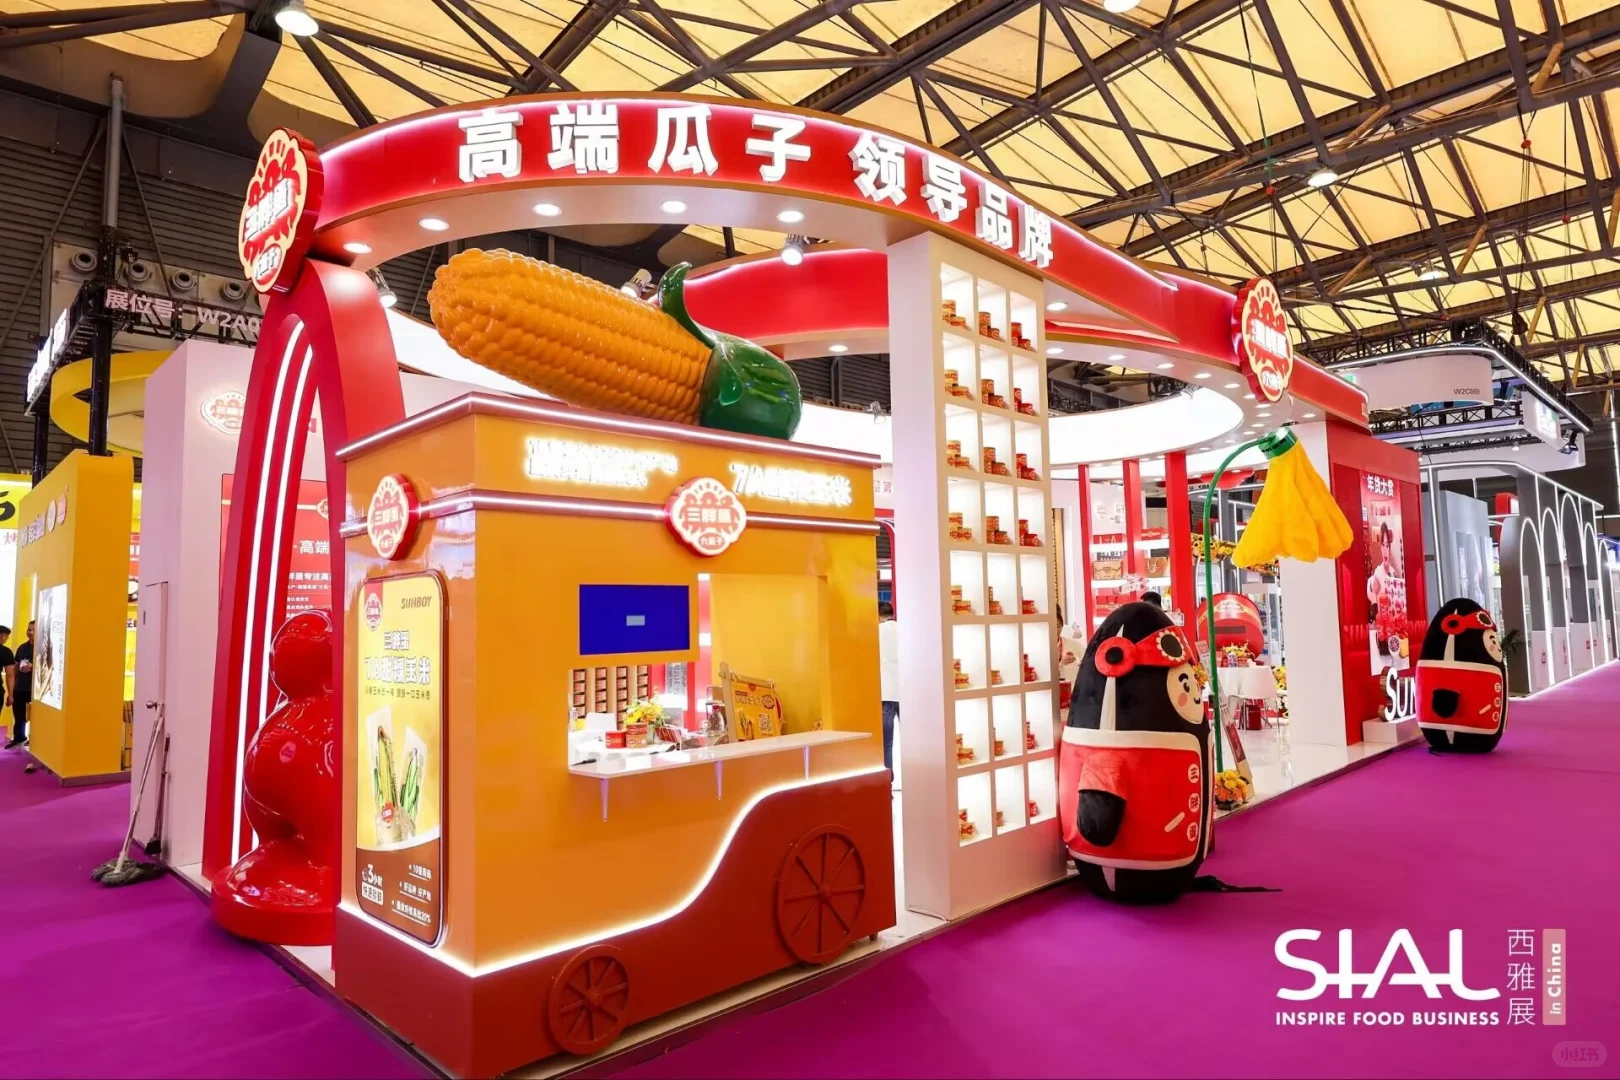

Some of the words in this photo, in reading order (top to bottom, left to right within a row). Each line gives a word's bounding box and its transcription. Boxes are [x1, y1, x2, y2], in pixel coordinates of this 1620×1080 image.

[458, 101, 811, 183] 高端瓜子
[848, 131, 1054, 268] 领导品牌
[401, 596, 432, 609] SUNBOY
